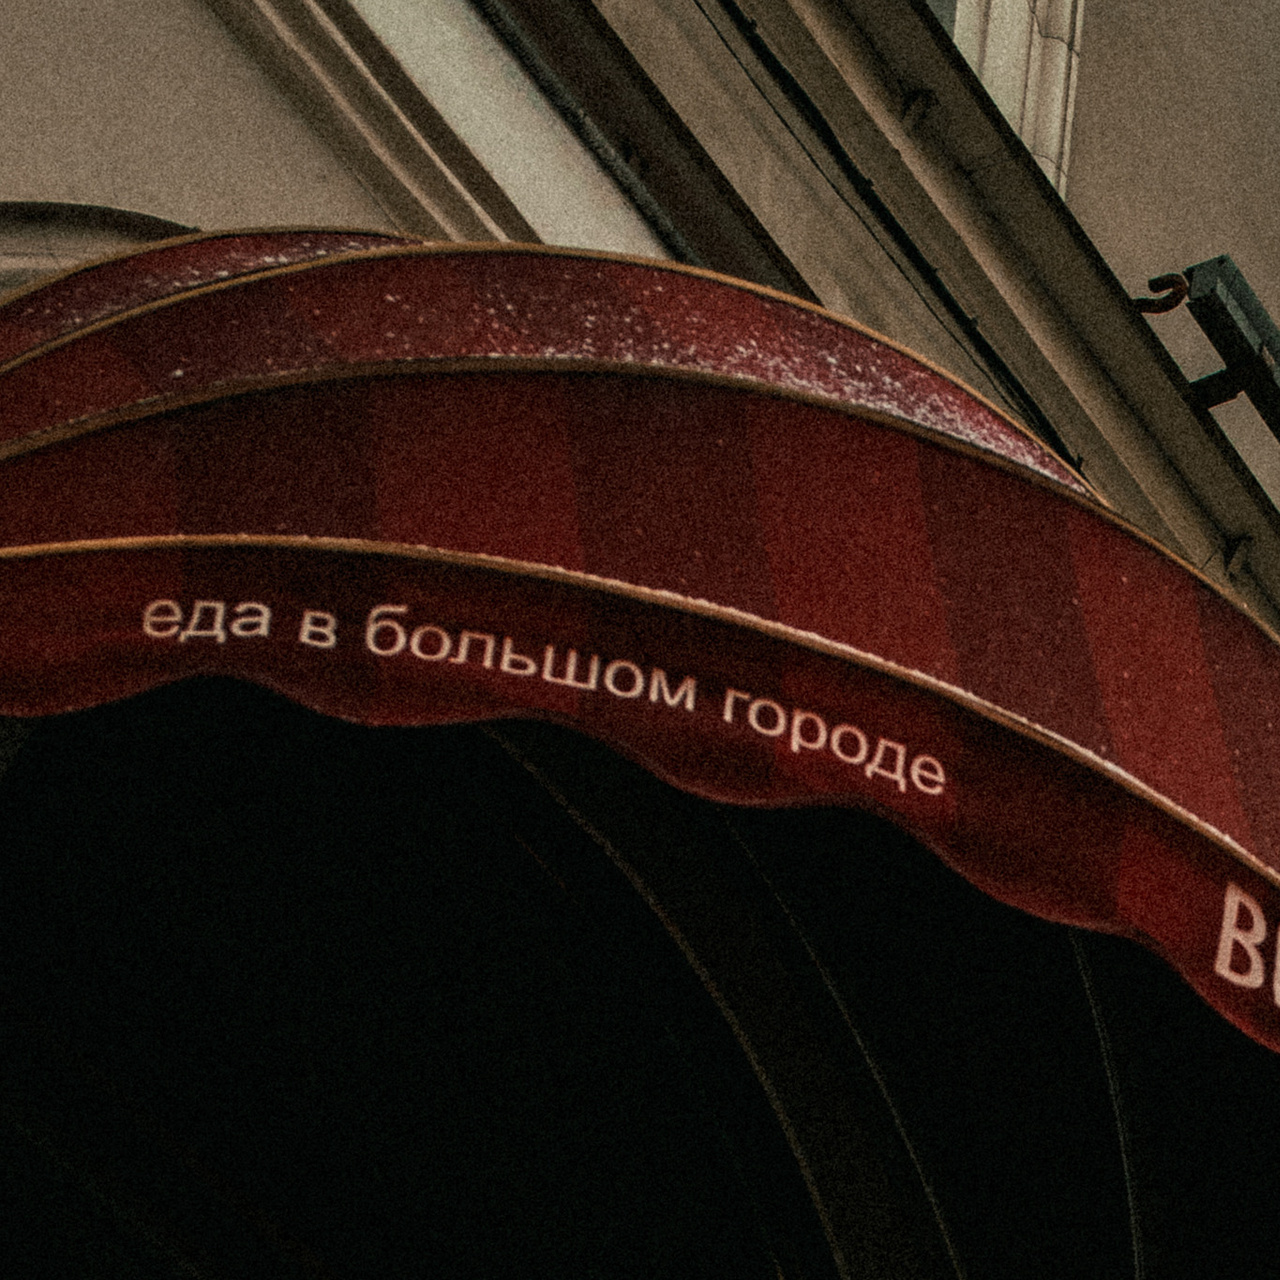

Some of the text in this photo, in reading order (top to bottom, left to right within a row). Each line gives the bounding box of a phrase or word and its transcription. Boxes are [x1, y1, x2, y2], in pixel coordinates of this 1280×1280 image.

[142, 598, 947, 797] еда в большом городе
